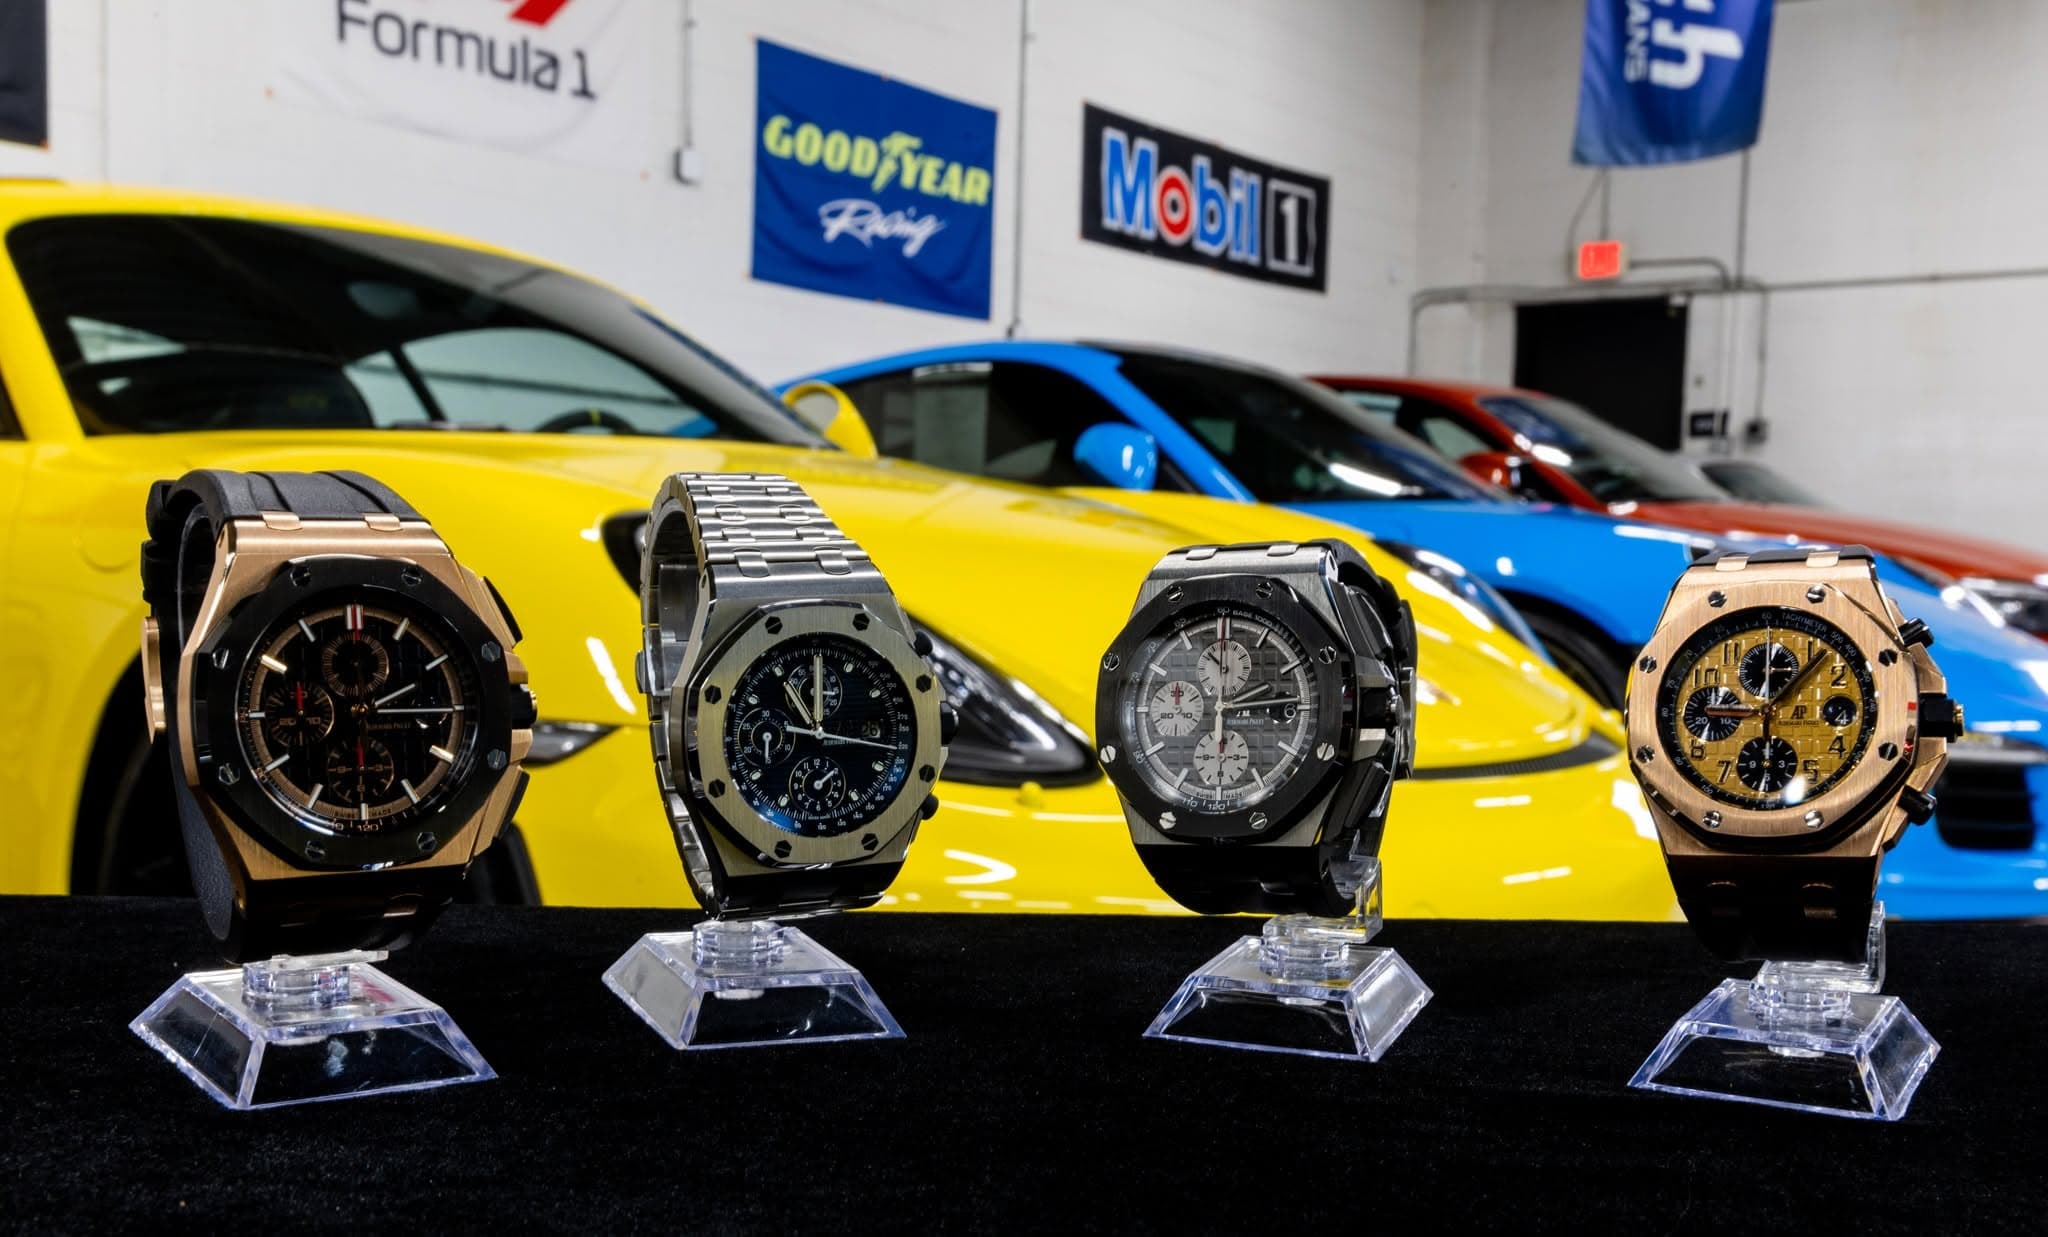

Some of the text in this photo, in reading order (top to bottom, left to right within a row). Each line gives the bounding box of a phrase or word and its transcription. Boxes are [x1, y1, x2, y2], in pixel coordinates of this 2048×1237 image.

[337, 0, 597, 101] Formula 1
[763, 114, 992, 206] GOODYEAR
[1101, 126, 1262, 266] Mobil
[817, 198, 948, 258] Racing
[1829, 661, 1848, 689] 2
[1283, 703, 1297, 719] 6
[1695, 716, 1709, 725] 20
[1834, 709, 1850, 726] 4
[1827, 734, 1847, 761] 4
[1716, 759, 1733, 785] 7
[1778, 760, 1786, 769] 3
